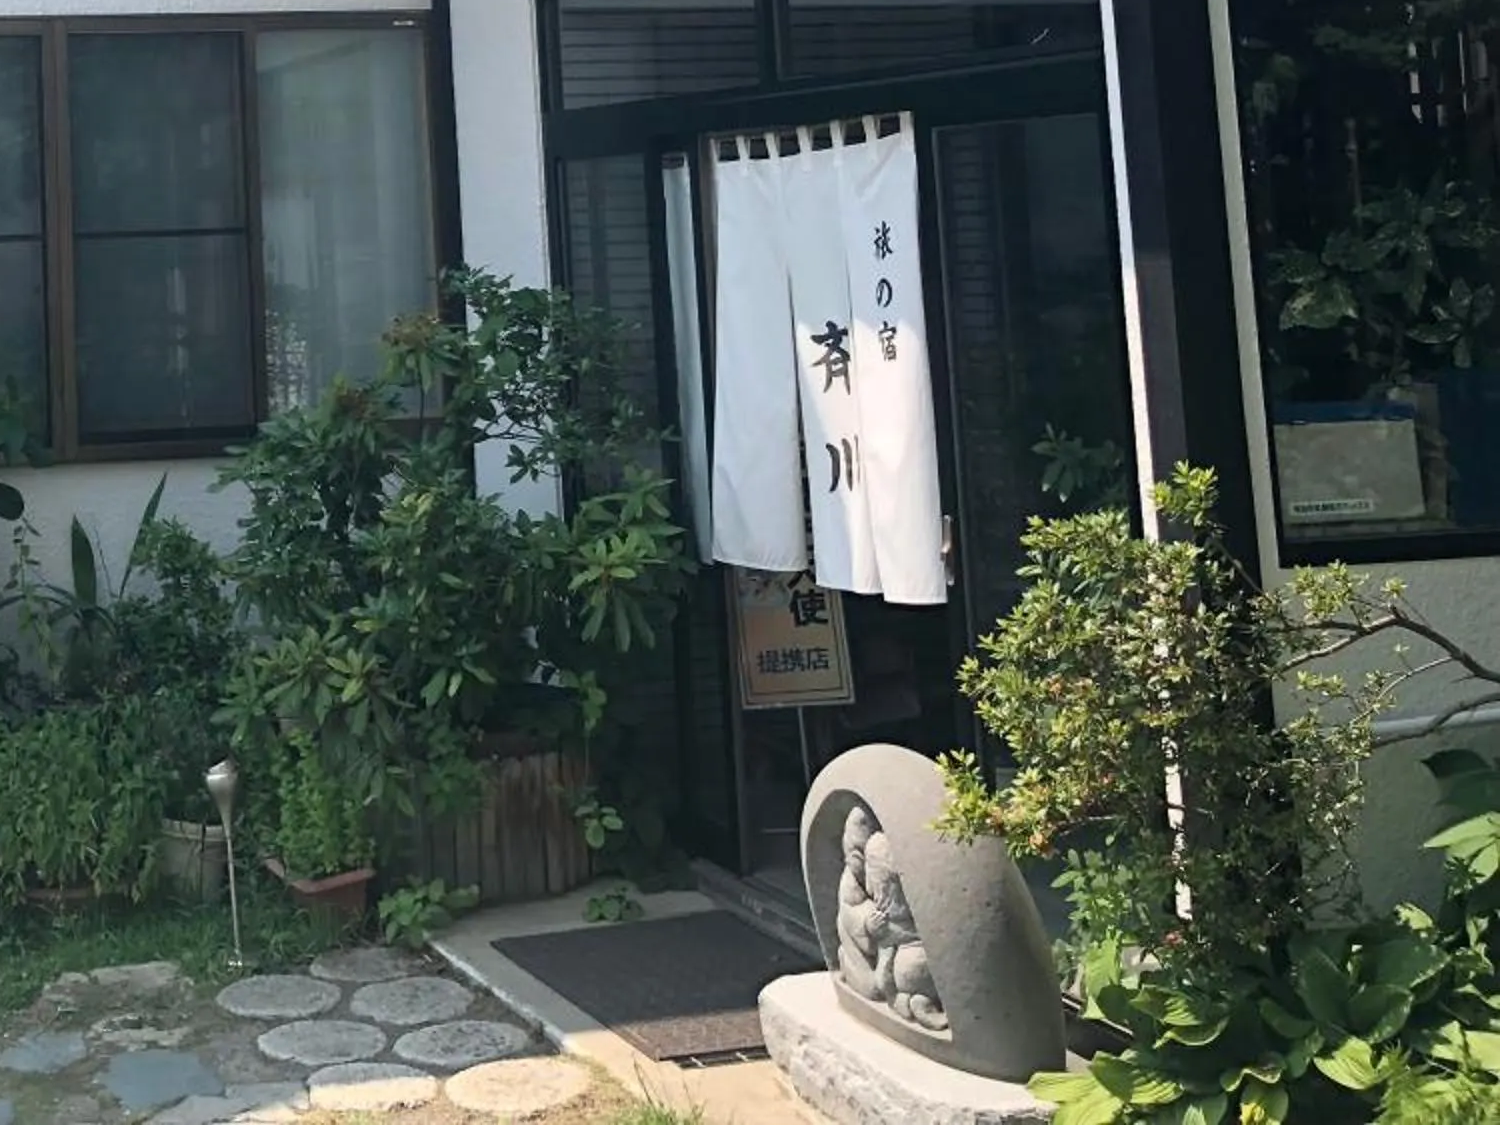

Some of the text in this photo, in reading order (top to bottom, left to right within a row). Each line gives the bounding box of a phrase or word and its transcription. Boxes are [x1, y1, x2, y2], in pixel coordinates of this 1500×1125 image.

[874, 220, 897, 362] 旅の宿
[757, 647, 830, 674] 提携店
